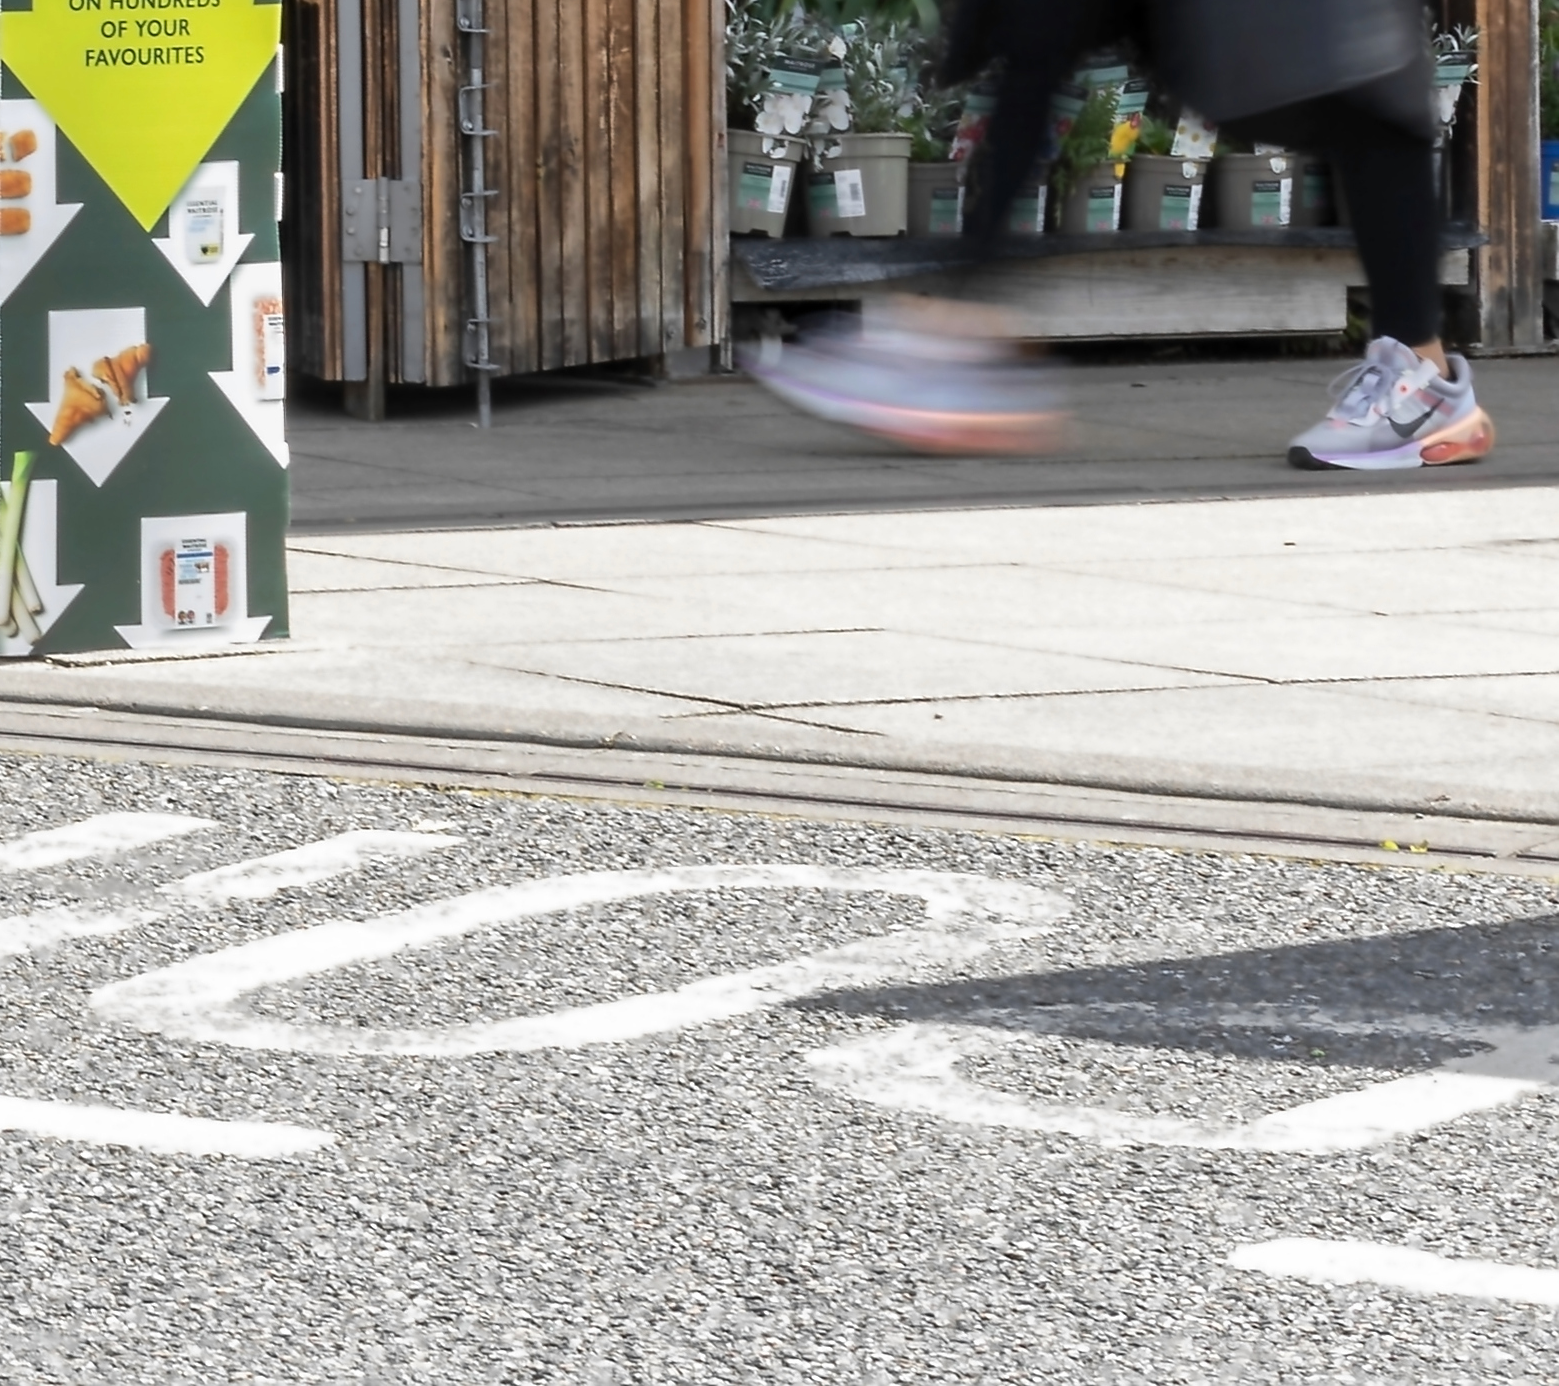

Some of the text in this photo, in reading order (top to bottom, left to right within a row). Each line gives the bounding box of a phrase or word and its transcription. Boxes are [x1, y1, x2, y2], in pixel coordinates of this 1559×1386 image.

[101, 19, 191, 38] OF YOUR
[86, 46, 204, 67] FAVOURITES
